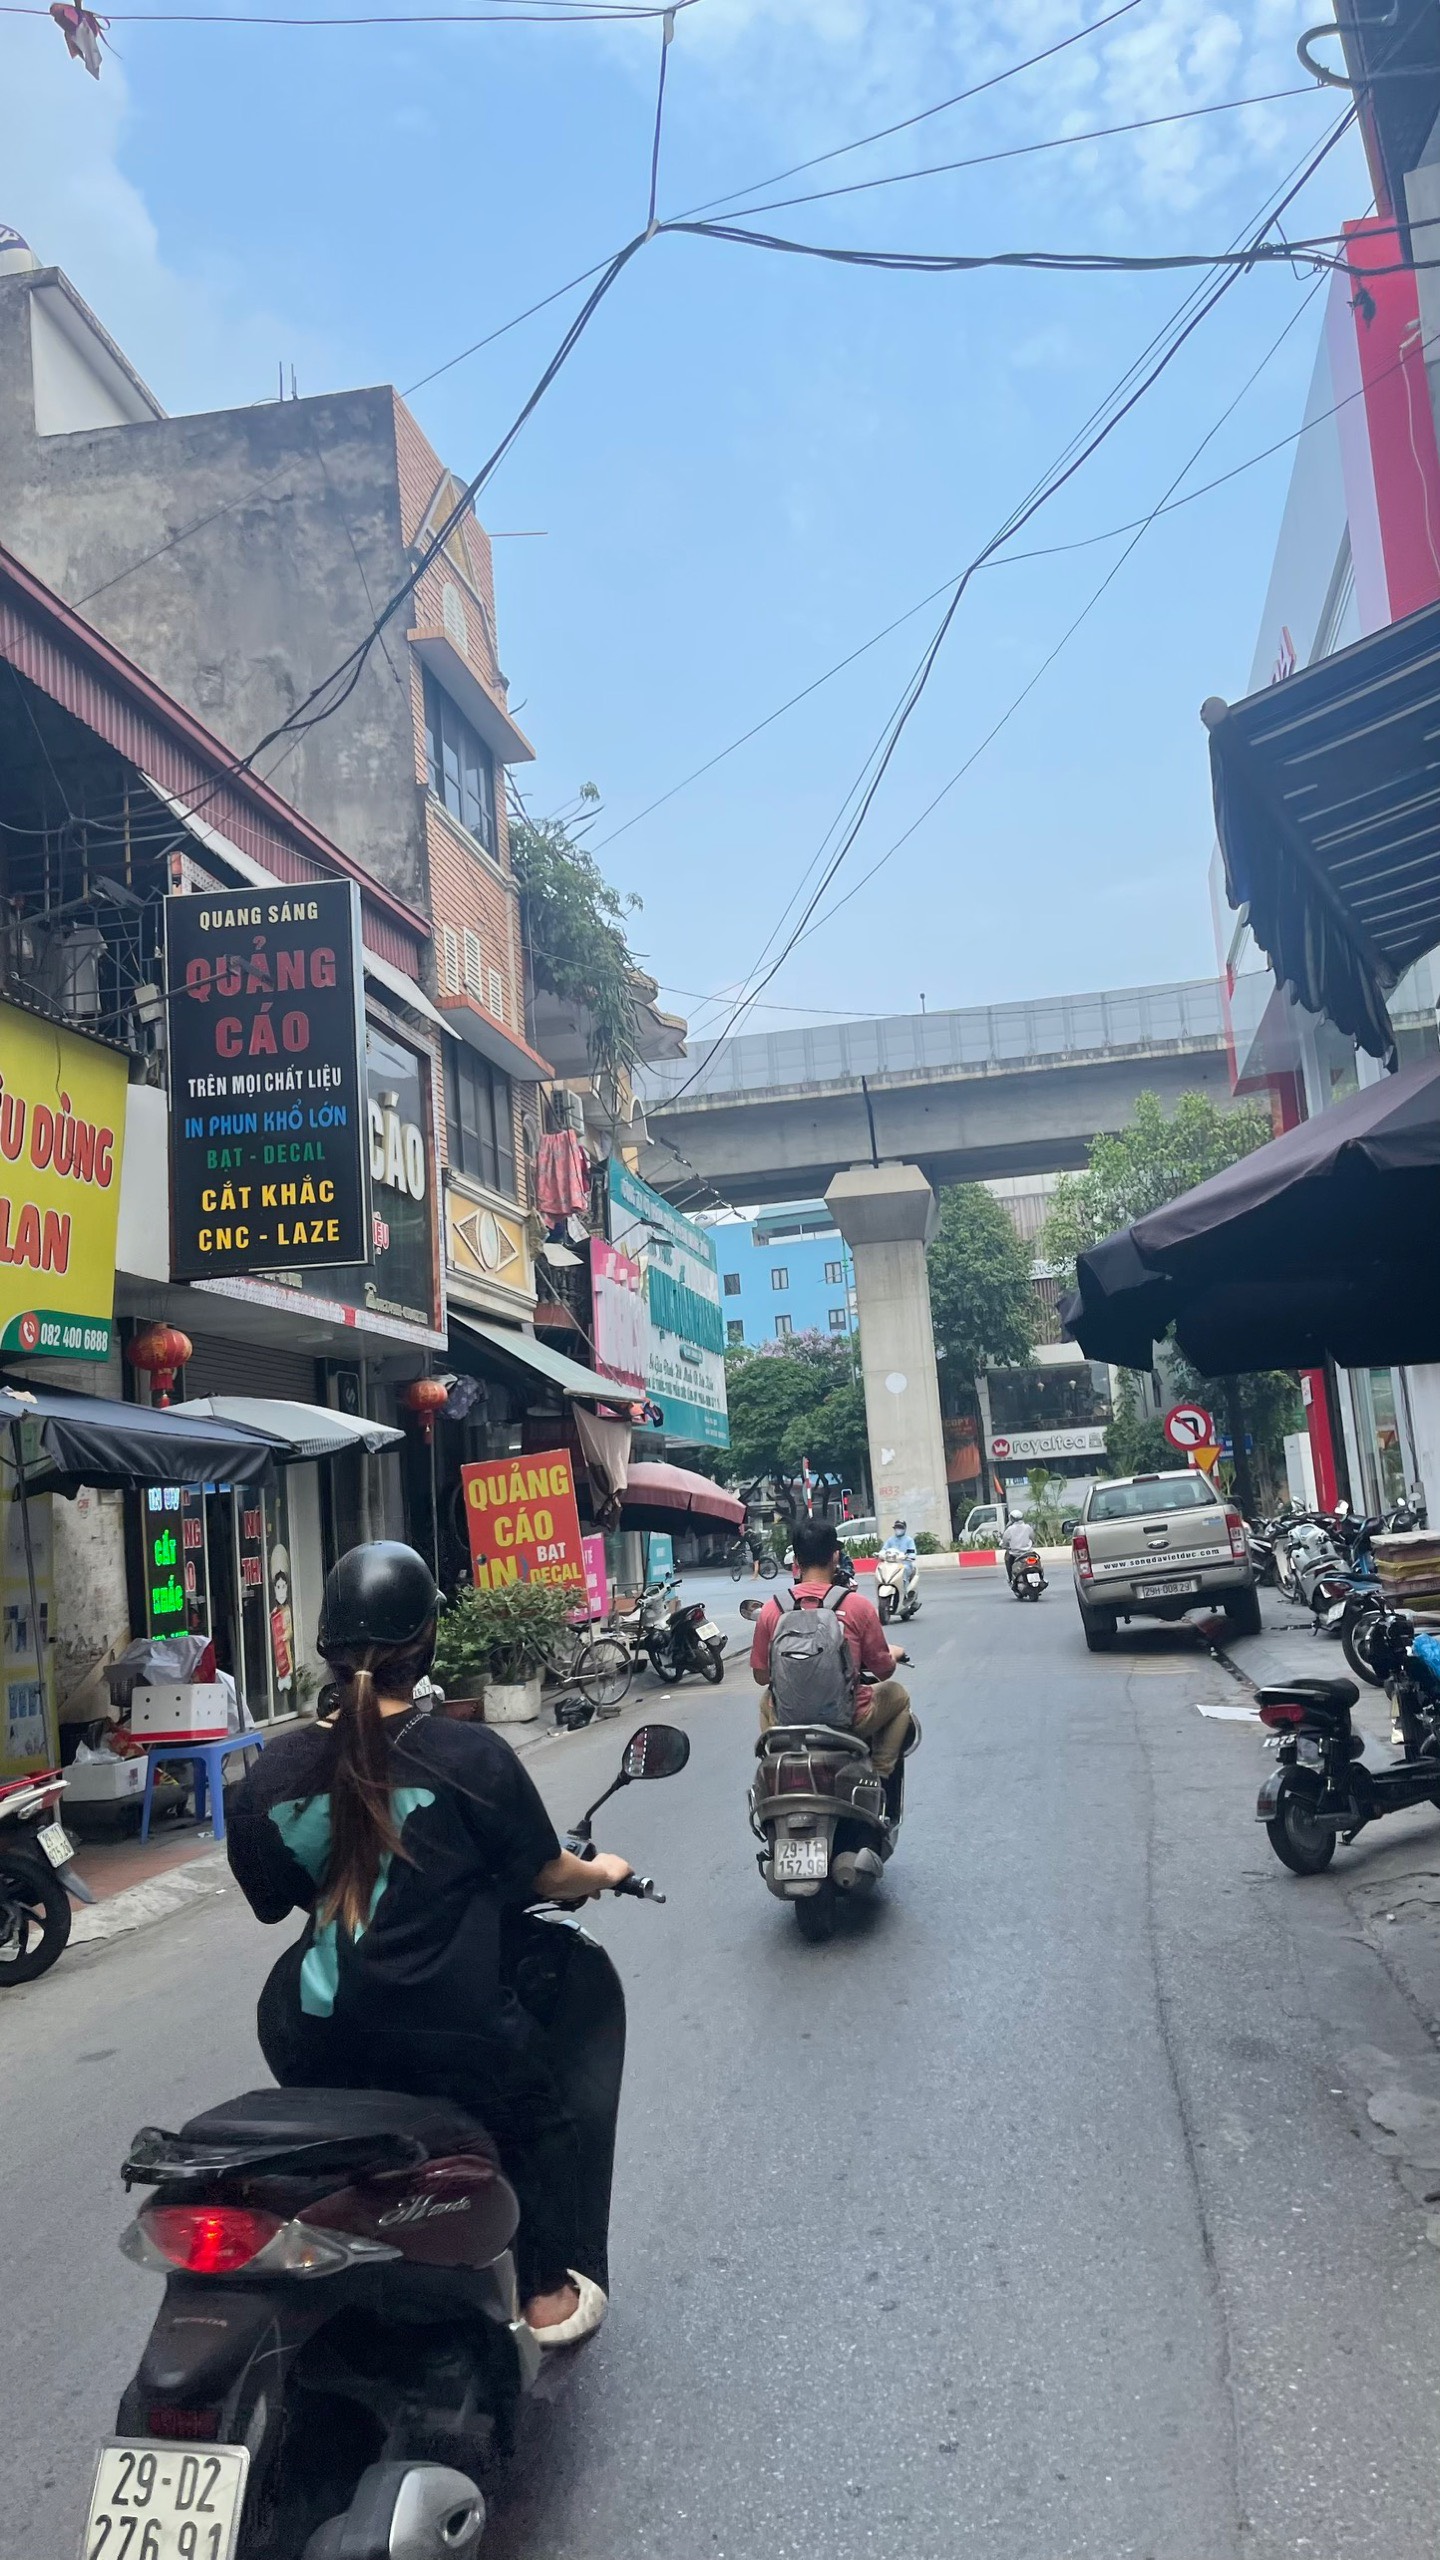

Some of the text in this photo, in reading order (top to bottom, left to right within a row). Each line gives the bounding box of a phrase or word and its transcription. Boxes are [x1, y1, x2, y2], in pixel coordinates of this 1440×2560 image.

[200, 901, 319, 931] QUANG SÁNG
[186, 935, 337, 1003] QUẢNG
[216, 1002, 310, 1058] CÁO
[188, 1064, 342, 1098] TRÊN MỌI CHẤT LIỆU
[185, 1099, 348, 1138] IN PHUN KHỔ LỚN
[30, 1091, 114, 1188] DÙNG
[207, 1148, 243, 1173] BẠT
[264, 1141, 326, 1164] DECAL
[368, 1091, 426, 1200] CÁO
[202, 1174, 335, 1212] CẮT KHẮC
[199, 1226, 250, 1252] CNC
[277, 1219, 340, 1245] LAZE
[41, 1323, 108, 1352] 082 400 6888
[1013, 1435, 1086, 1455] royaltea
[468, 1462, 570, 1512] QUẢNG
[494, 1507, 554, 1547] CÁO
[536, 1542, 567, 1564] BẠT
[530, 1562, 582, 1584] DECAL
[779, 1860, 827, 1876] 152.96
[111, 2451, 222, 2512] 29-D2
